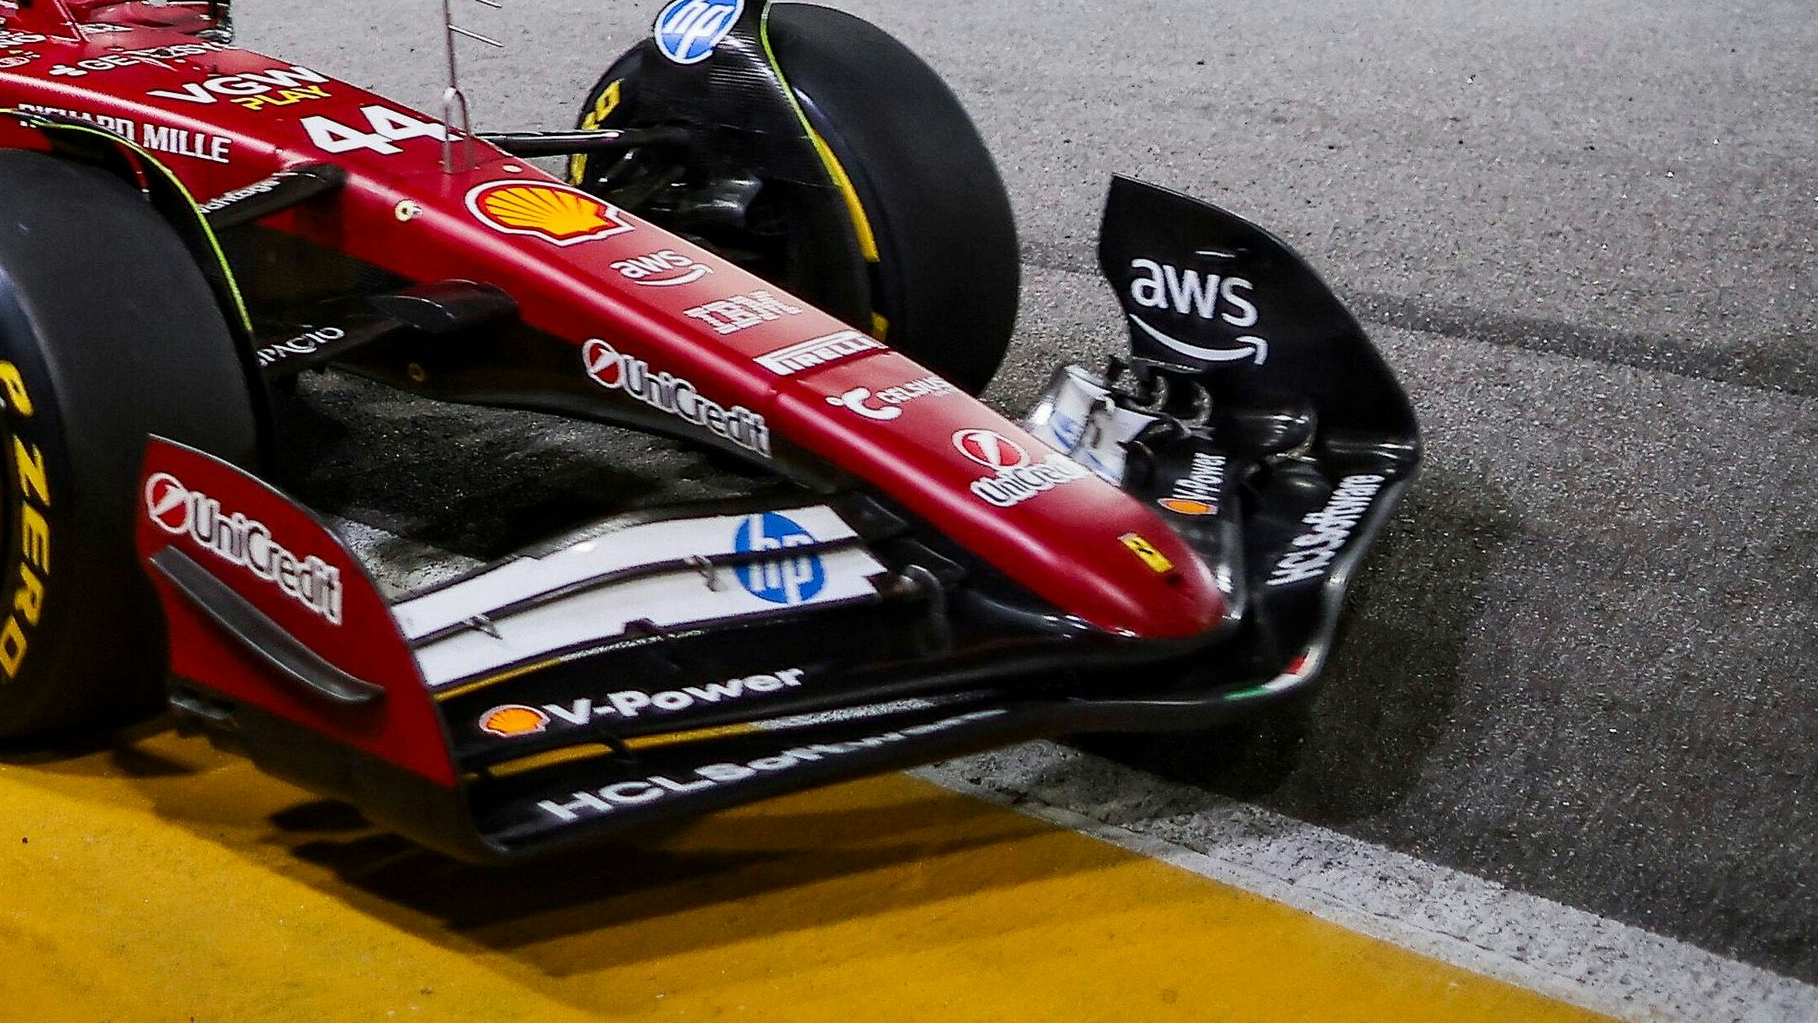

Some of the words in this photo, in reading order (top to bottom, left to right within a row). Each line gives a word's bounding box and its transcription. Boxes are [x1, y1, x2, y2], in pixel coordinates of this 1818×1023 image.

[146, 65, 330, 104] VGW
[229, 85, 332, 111] PLAY
[143, 123, 233, 164] MILLE
[299, 104, 465, 155] 44
[610, 249, 693, 281] aws
[682, 290, 803, 336] IBM
[1129, 258, 1259, 328] aws
[753, 329, 887, 376] PIRELLI
[623, 354, 772, 458] UniCredit
[190, 491, 343, 626] UniCredit
[737, 511, 825, 604] hp
[543, 667, 805, 726] V-Power
